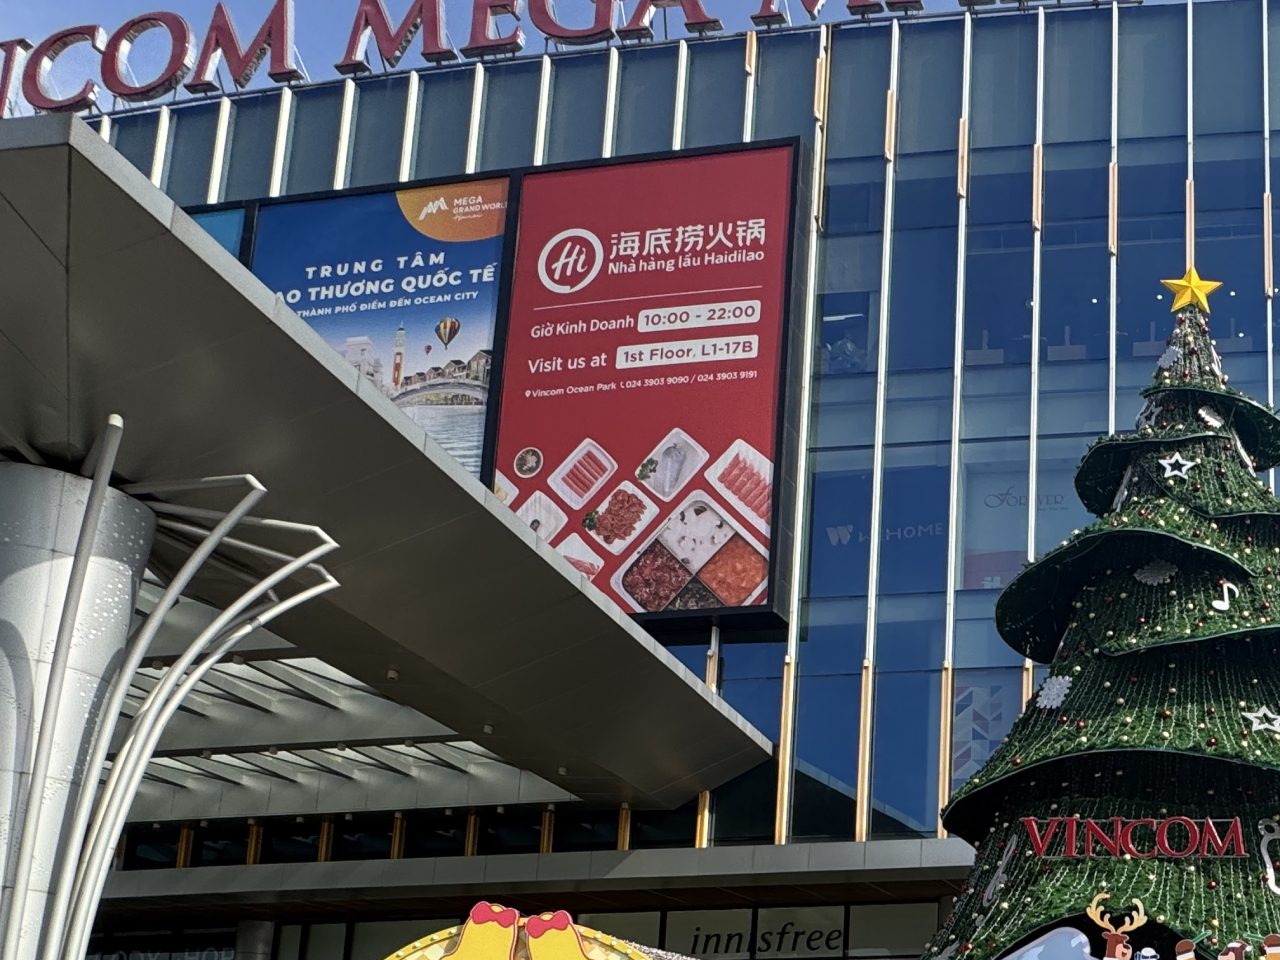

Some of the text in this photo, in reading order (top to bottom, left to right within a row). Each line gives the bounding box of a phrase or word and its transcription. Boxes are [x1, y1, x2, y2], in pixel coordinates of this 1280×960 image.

[453, 195, 483, 206] MEGA
[453, 205, 481, 214] GRAND
[609, 219, 766, 260] 海底捞火锅
[306, 251, 445, 279] TRUNG TÂM
[608, 258, 635, 275] Nhà
[639, 258, 675, 273] hàng
[704, 249, 765, 264] Haidilao
[308, 278, 394, 300] THƯƠNG
[401, 267, 461, 293] QUỐC
[469, 262, 498, 283] TẾ
[335, 301, 357, 314] PHỐ
[414, 294, 451, 305] OCEAN
[454, 291, 478, 301] CITY
[530, 324, 554, 338] Giờ
[556, 321, 587, 335] Kinh
[590, 316, 634, 332] Doanh
[644, 310, 690, 326] 10:00
[706, 305, 756, 321] 22:00
[528, 357, 563, 374] Visit
[568, 357, 586, 369] us
[591, 353, 608, 367] at
[623, 350, 644, 363] 1st
[701, 340, 754, 357] L1-17B
[532, 388, 564, 398] Vincom
[566, 385, 595, 395] Ocean
[597, 382, 617, 391] Park
[626, 380, 642, 389] 024
[643, 377, 665, 387] 3903
[666, 375, 690, 385] 9090
[697, 374, 714, 382] 024
[716, 371, 738, 380] 3903
[740, 370, 758, 379] 9191
[1019, 816, 1250, 858] VINCOM
